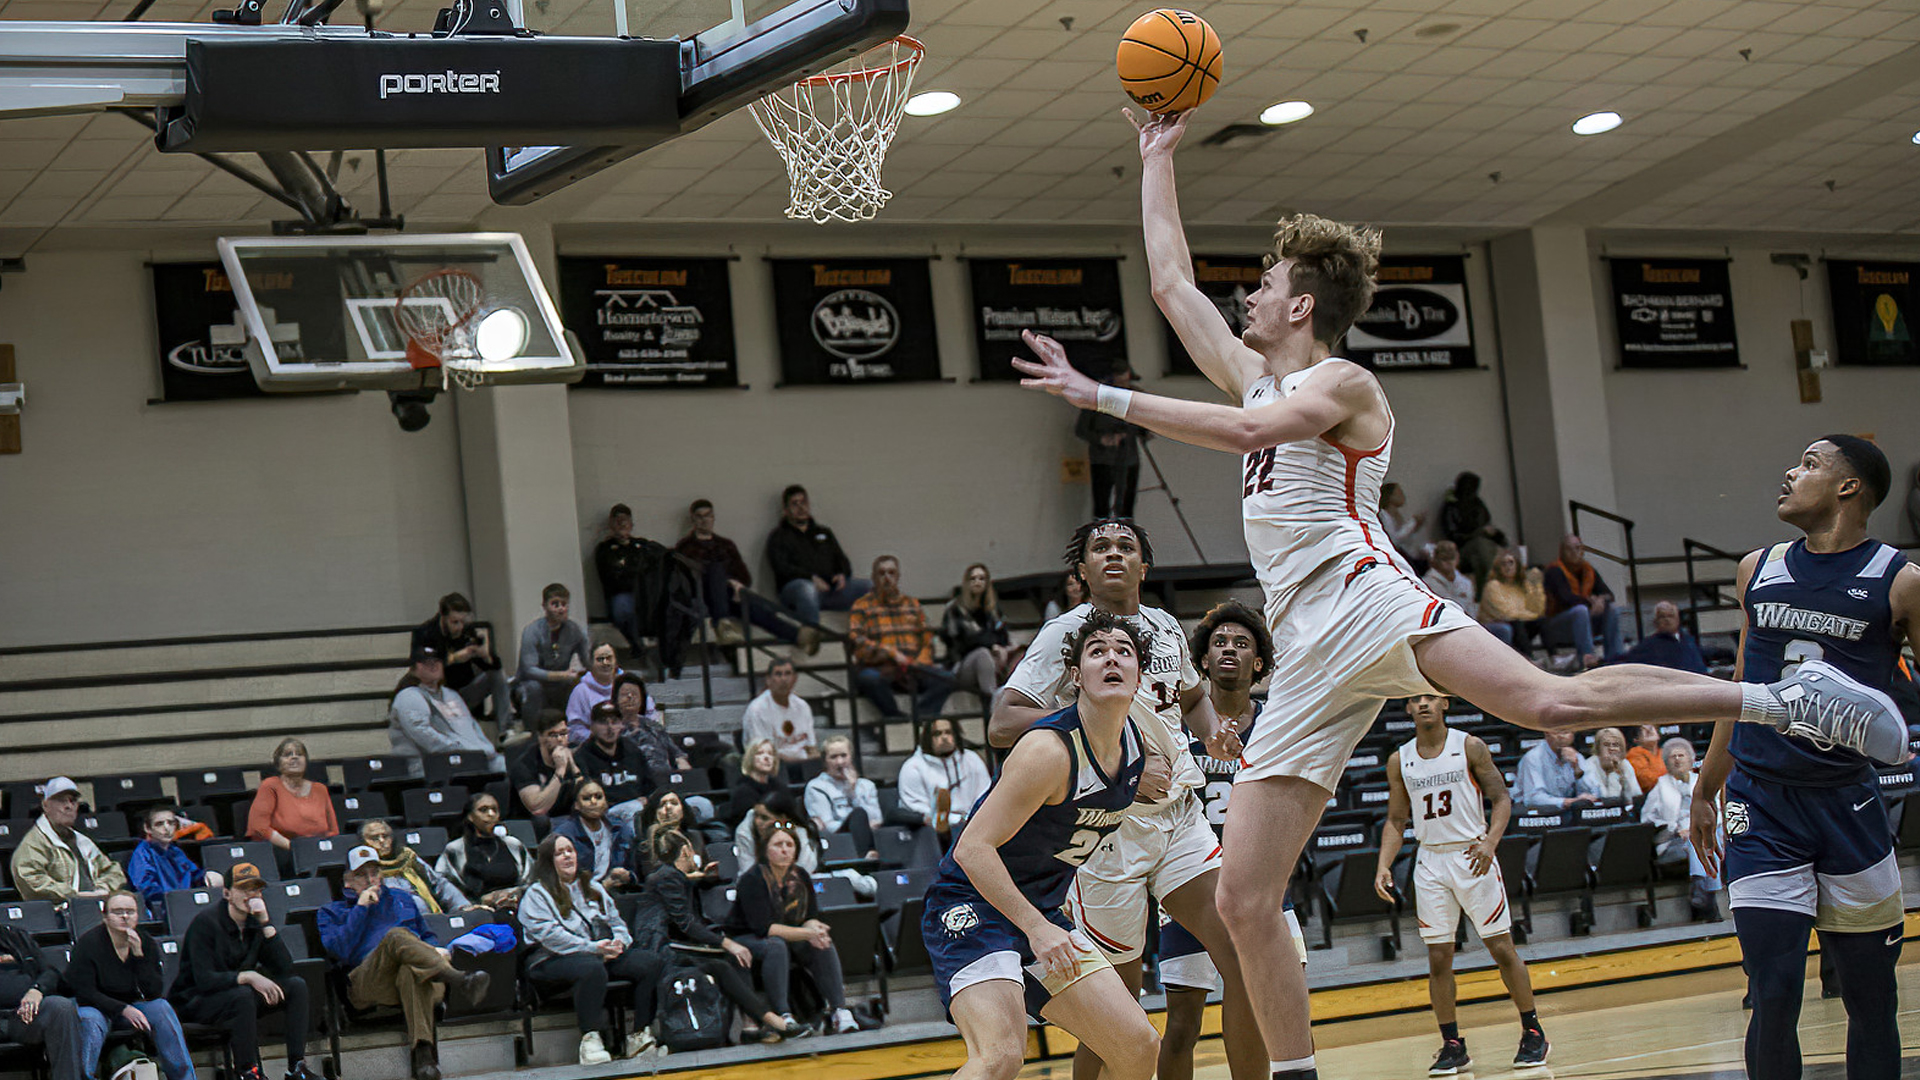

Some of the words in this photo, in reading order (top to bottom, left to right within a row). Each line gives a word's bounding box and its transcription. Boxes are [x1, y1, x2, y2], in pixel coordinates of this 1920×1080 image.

[380, 70, 500, 99] porter
[1753, 602, 1870, 641] WINGATE
[1422, 789, 1453, 820] 13
